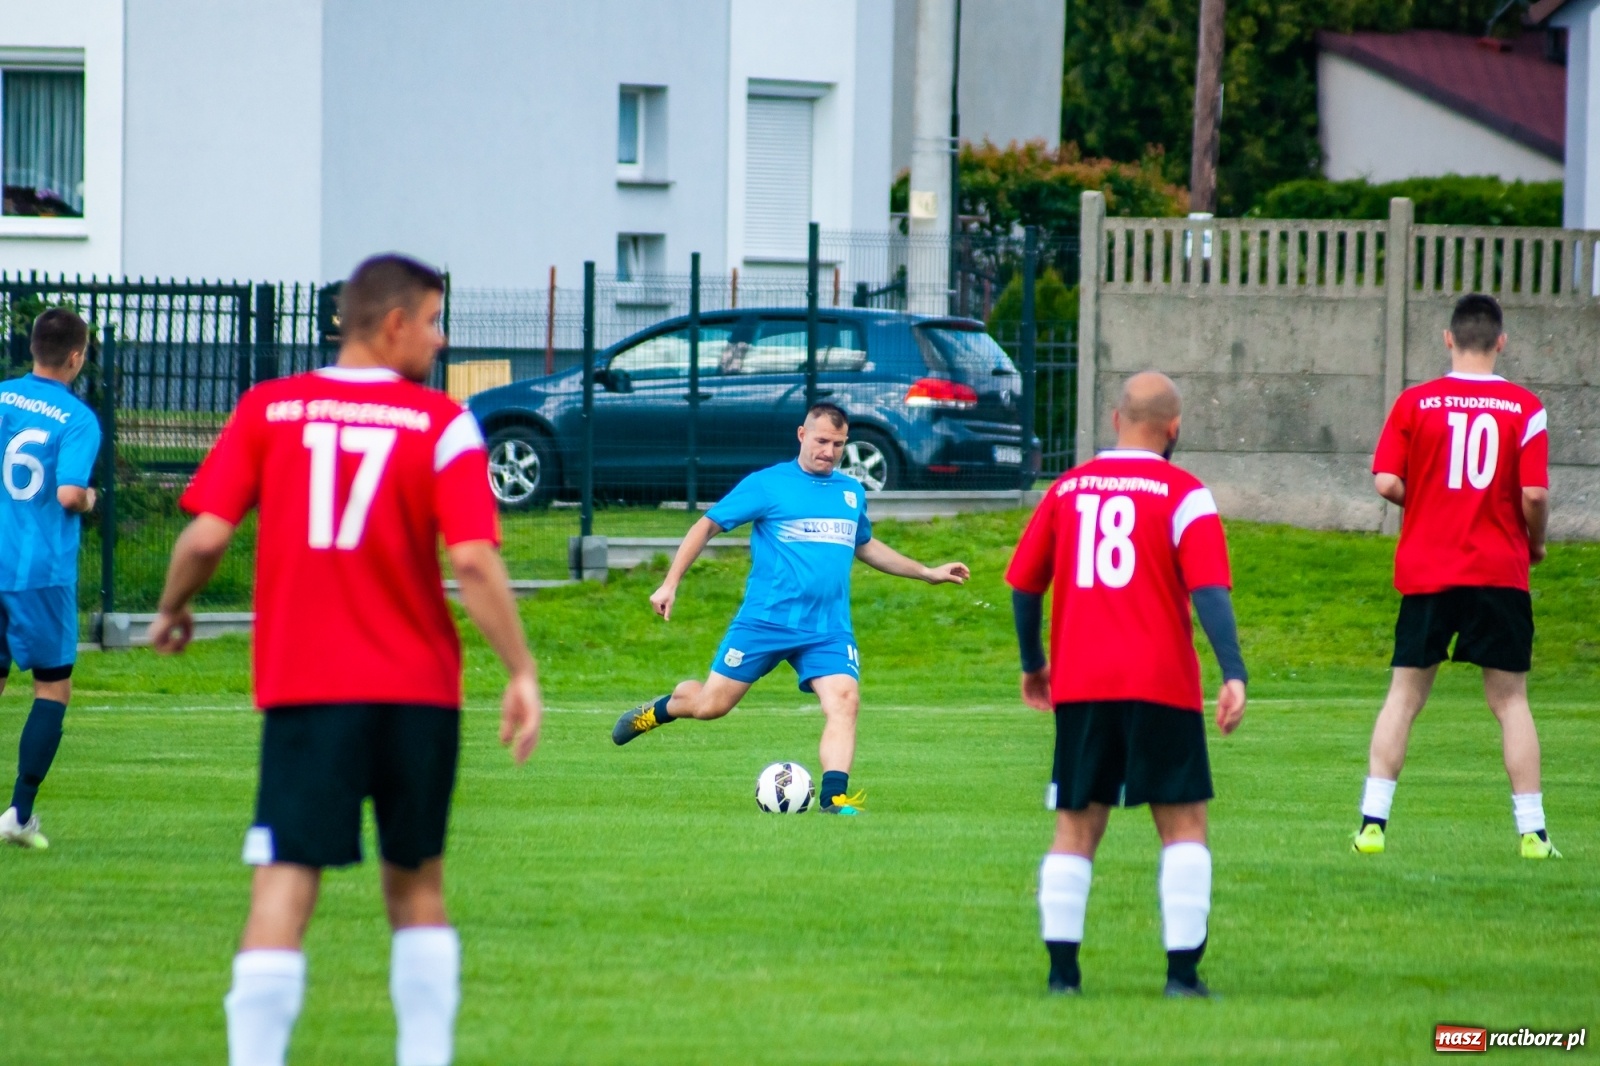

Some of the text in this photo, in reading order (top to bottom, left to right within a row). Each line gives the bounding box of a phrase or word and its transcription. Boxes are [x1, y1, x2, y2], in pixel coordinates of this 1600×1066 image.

[0, 391, 71, 424] KORNOWAC
[305, 399, 431, 433] STUDZIENNA
[1420, 396, 1522, 414] LKS STUDZIENNA
[1447, 411, 1500, 490] 10
[302, 421, 398, 550] 17
[1078, 475, 1169, 497] STUDZIENNA
[803, 521, 854, 535] EKO-BUD
[1075, 493, 1136, 589] 18
